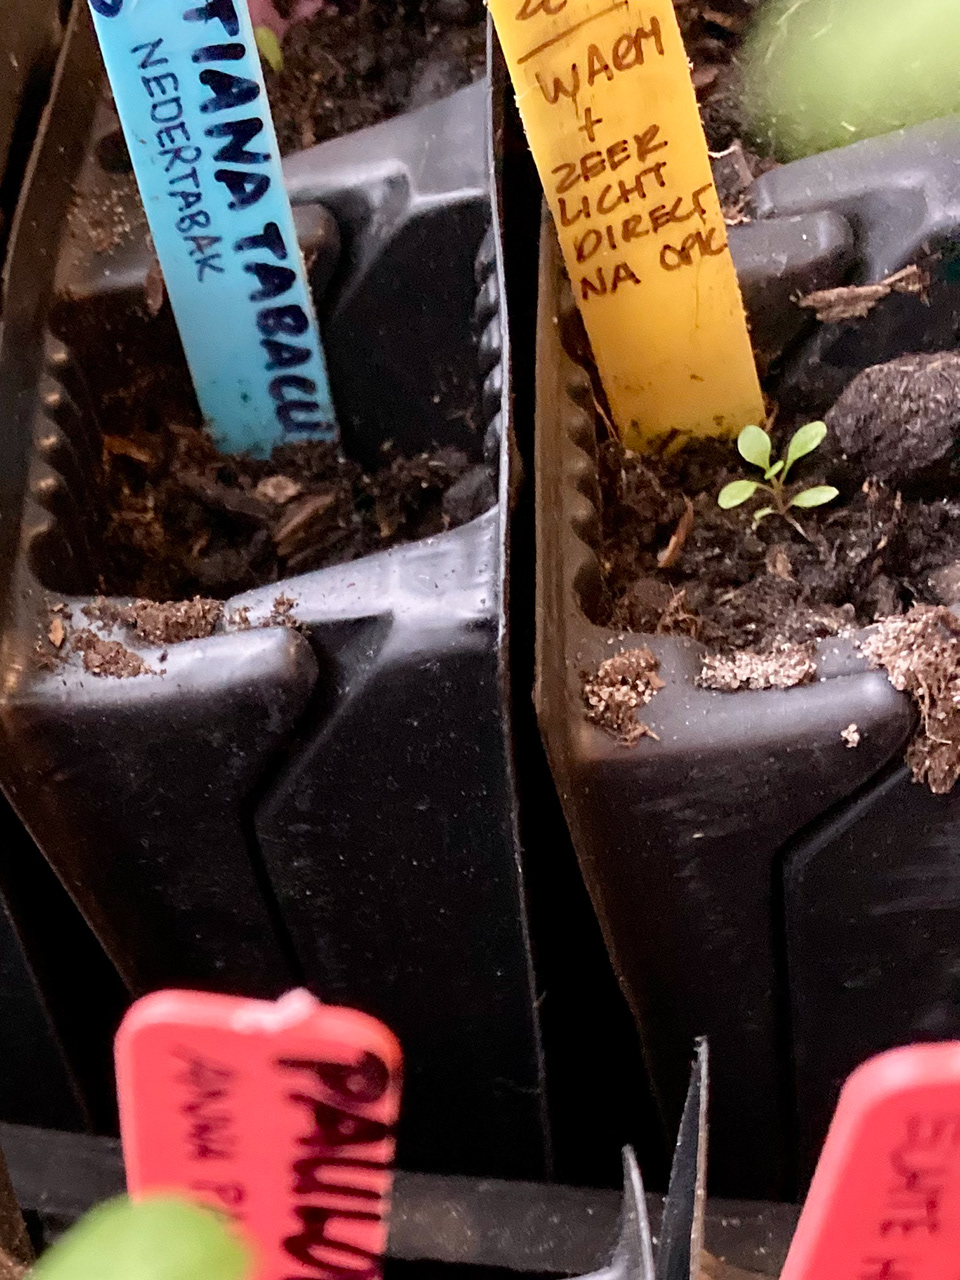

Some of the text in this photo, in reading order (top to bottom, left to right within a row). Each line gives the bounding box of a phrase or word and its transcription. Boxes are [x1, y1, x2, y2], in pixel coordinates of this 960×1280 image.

[130, 37, 224, 283] NEDERTABAK
[552, 123, 669, 195] ZEER
[558, 161, 668, 227] LICHT
[573, 182, 714, 265] DIRECT
[578, 267, 641, 300] NA
